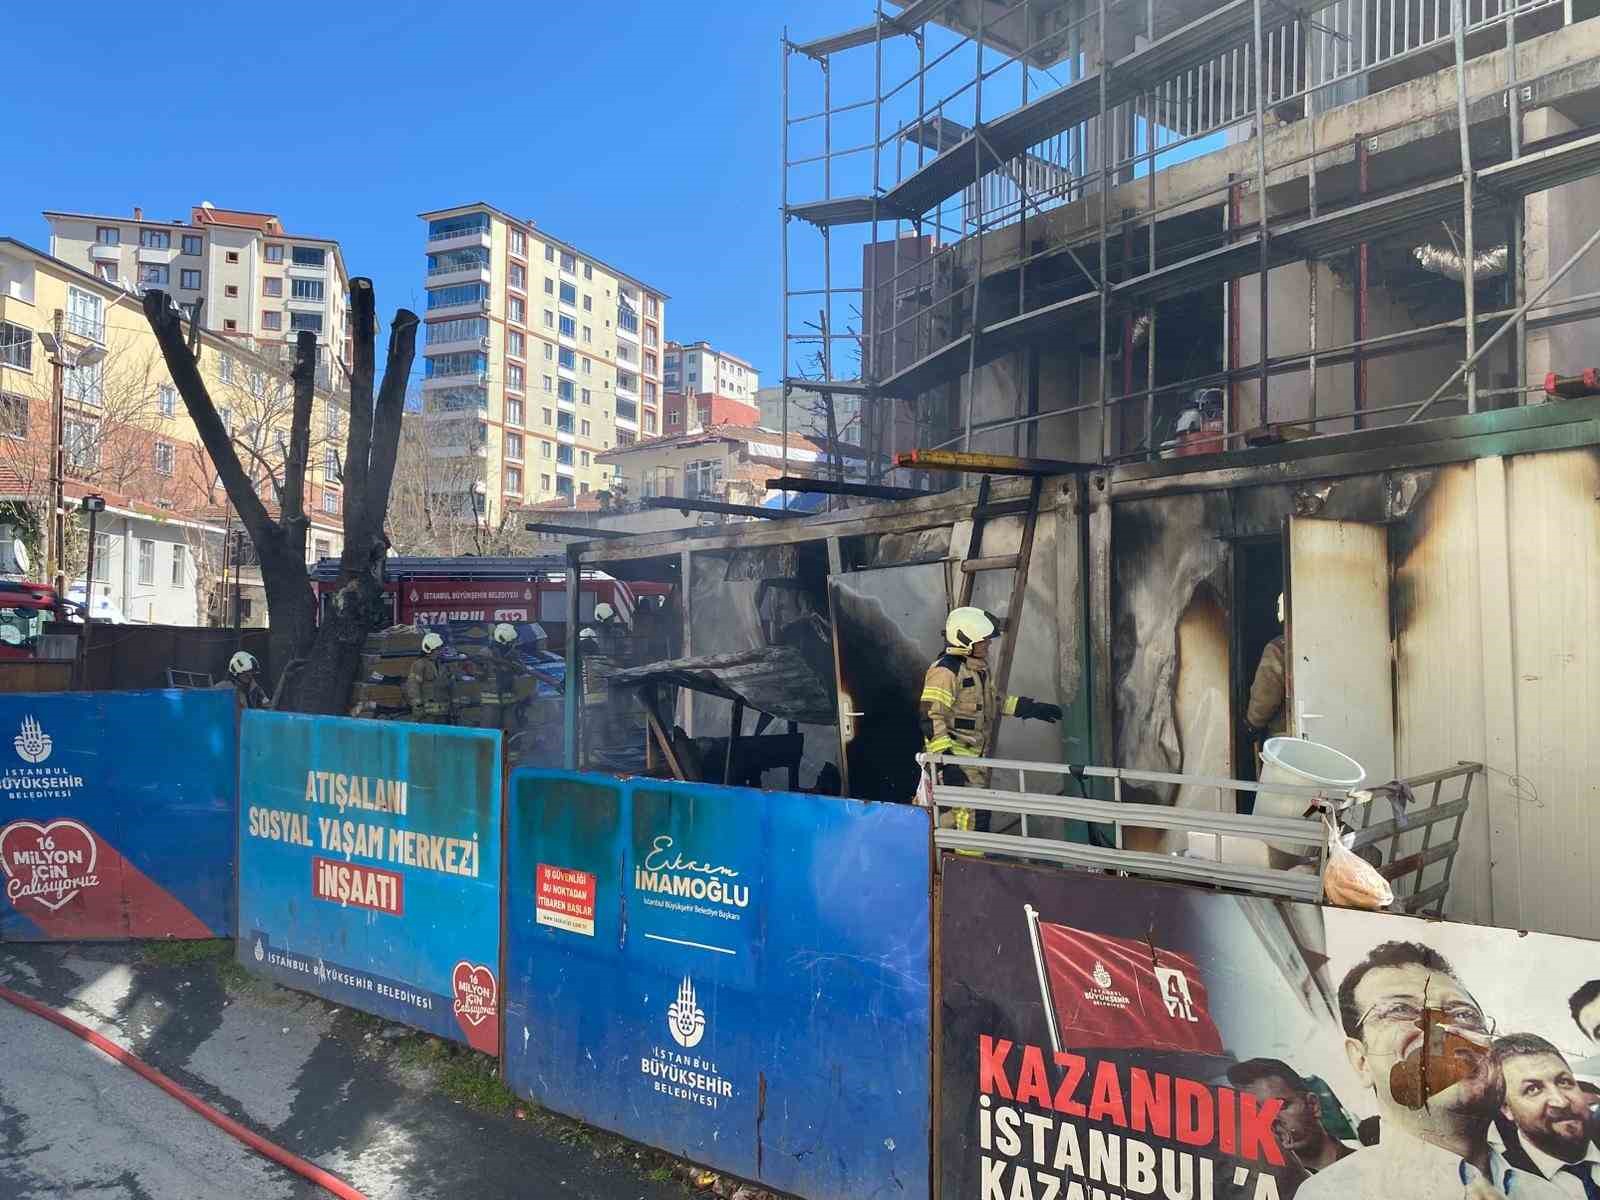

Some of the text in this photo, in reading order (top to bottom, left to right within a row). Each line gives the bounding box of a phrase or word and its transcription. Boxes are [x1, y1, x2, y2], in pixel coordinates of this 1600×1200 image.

[0, 774, 84, 790] ÜYÜKŞEHİR
[5, 767, 69, 776] İSTANBUL
[9, 790, 72, 799] BELEDİYESİ
[305, 770, 407, 814] ATIŞALANI
[36, 836, 55, 850] 16
[249, 806, 479, 878] SOSYAL YAŞAM MERKEZİ
[319, 861, 397, 911] İNŞAATI
[552, 884, 587, 900] NOKTADAN
[635, 865, 749, 908] İMAMOĞLU
[268, 952, 310, 973] İSTANBUL
[376, 983, 433, 1010] BELEDİYESİ
[641, 1057, 733, 1098] BÜYÜKŞEHİR
[655, 1046, 718, 1074] İSTANBUL
[654, 1081, 718, 1110] BELEDİYESİ
[978, 1033, 1287, 1167] KAZANDIK
